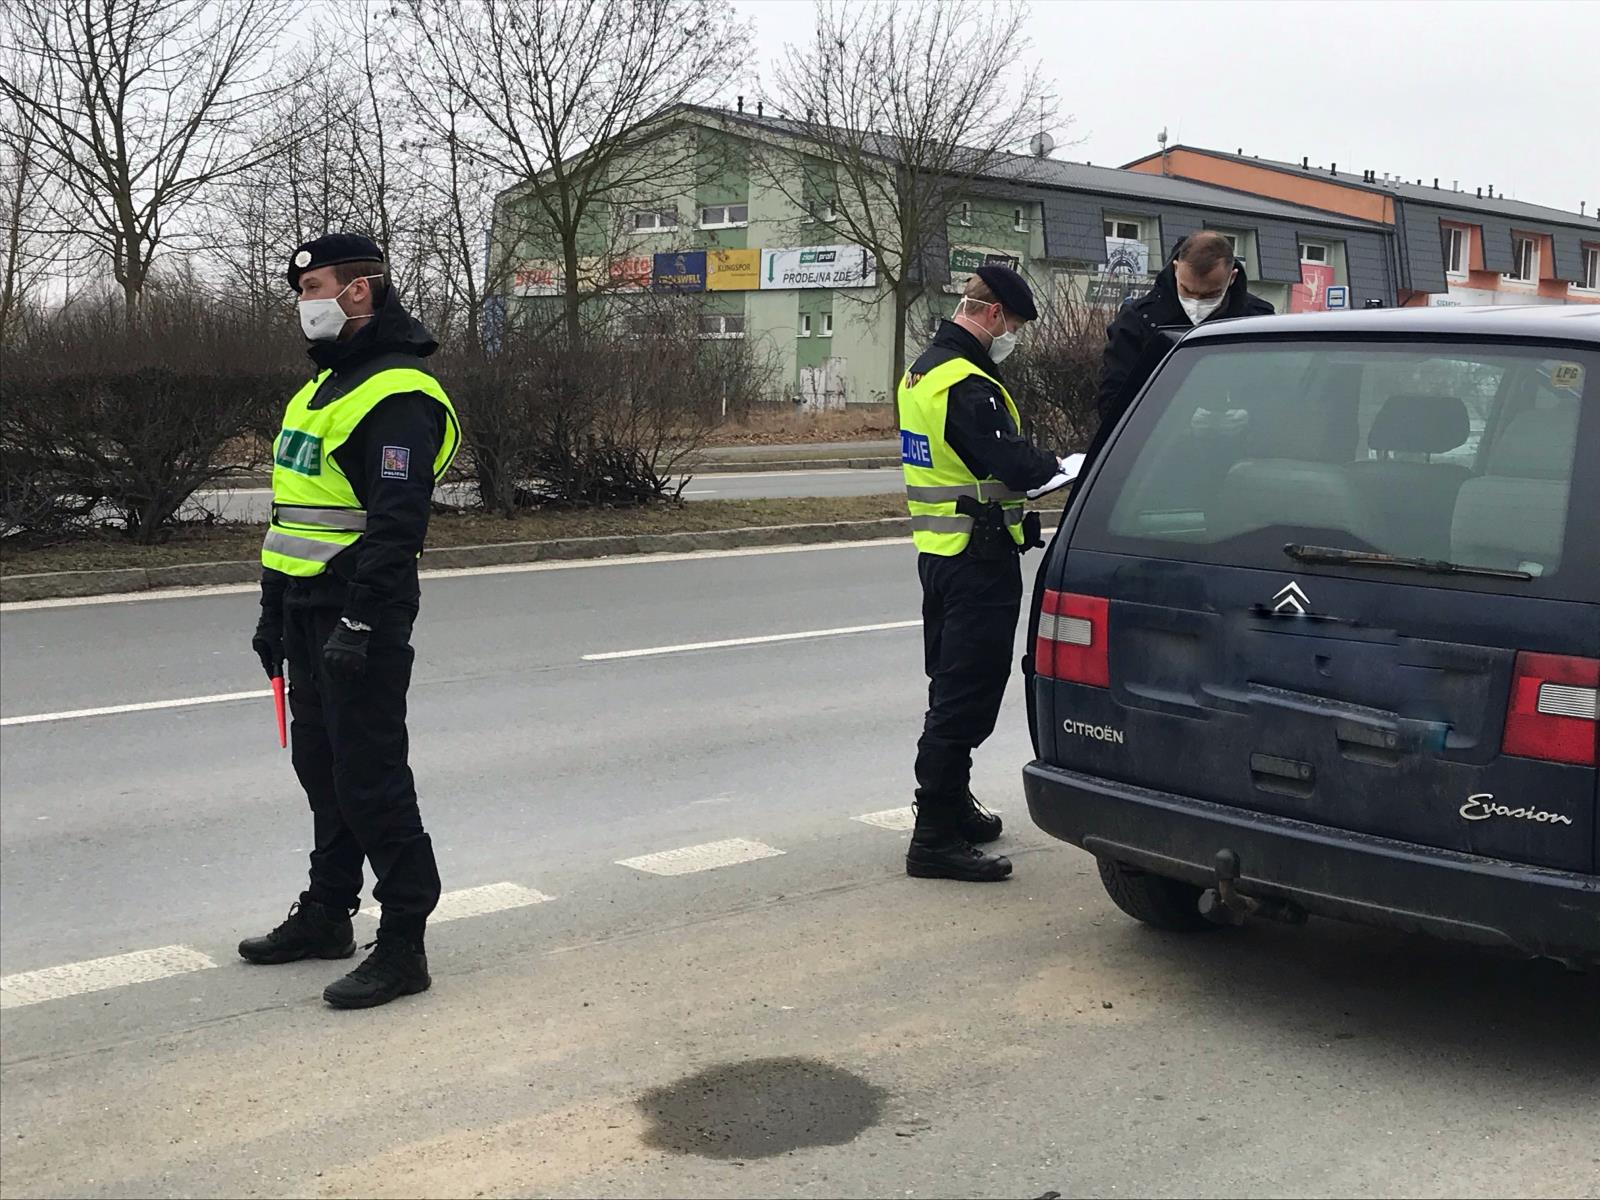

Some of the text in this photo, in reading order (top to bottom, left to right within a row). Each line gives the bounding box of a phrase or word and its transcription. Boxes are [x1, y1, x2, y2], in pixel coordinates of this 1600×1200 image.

[783, 270, 851, 284] PRODEJNA ZDE
[1555, 367, 1578, 379] LPG
[901, 435, 931, 462] LICIE
[1063, 718, 1124, 744] CITROËN
[1459, 793, 1572, 825] Evasion
